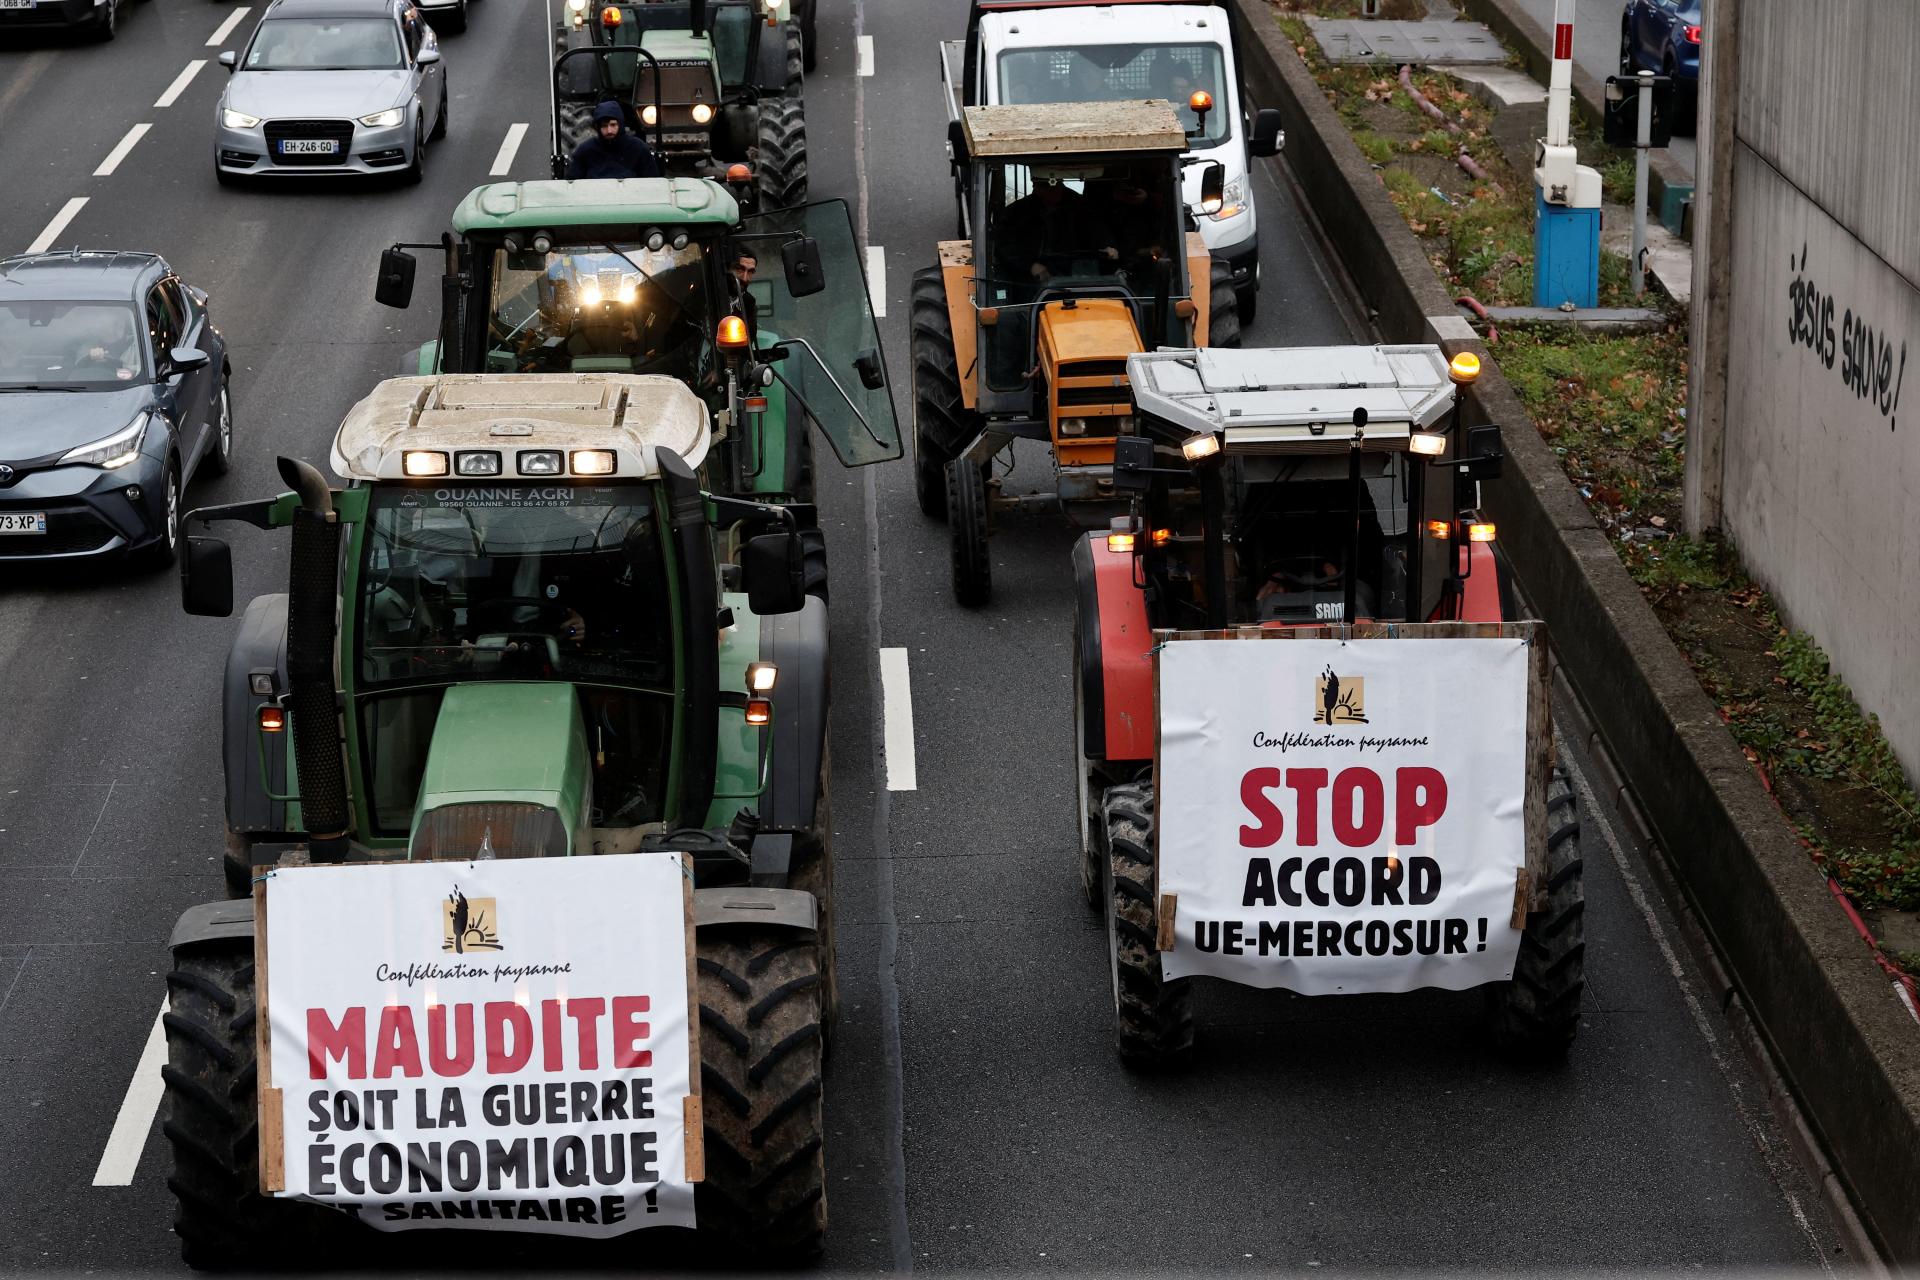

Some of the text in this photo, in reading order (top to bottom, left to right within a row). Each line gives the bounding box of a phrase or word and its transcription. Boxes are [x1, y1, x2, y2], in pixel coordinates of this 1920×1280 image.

[434, 488, 575, 500] OUANNE AGRI
[1315, 602, 1345, 619] SAM
[1253, 731, 1429, 754] Confédération paysanne
[1238, 766, 1448, 848] STOP
[1242, 856, 1442, 907] ACCORD
[1195, 918, 1470, 957] UE-MERCOSUR
[376, 962, 572, 988] Confédération paysanne
[306, 995, 653, 1079] MAUDITE
[308, 1078, 655, 1132] SOIT LA GUERRE
[308, 1131, 660, 1196] ÉCONOMIQUE
[382, 1194, 627, 1225] SANITAIRE
